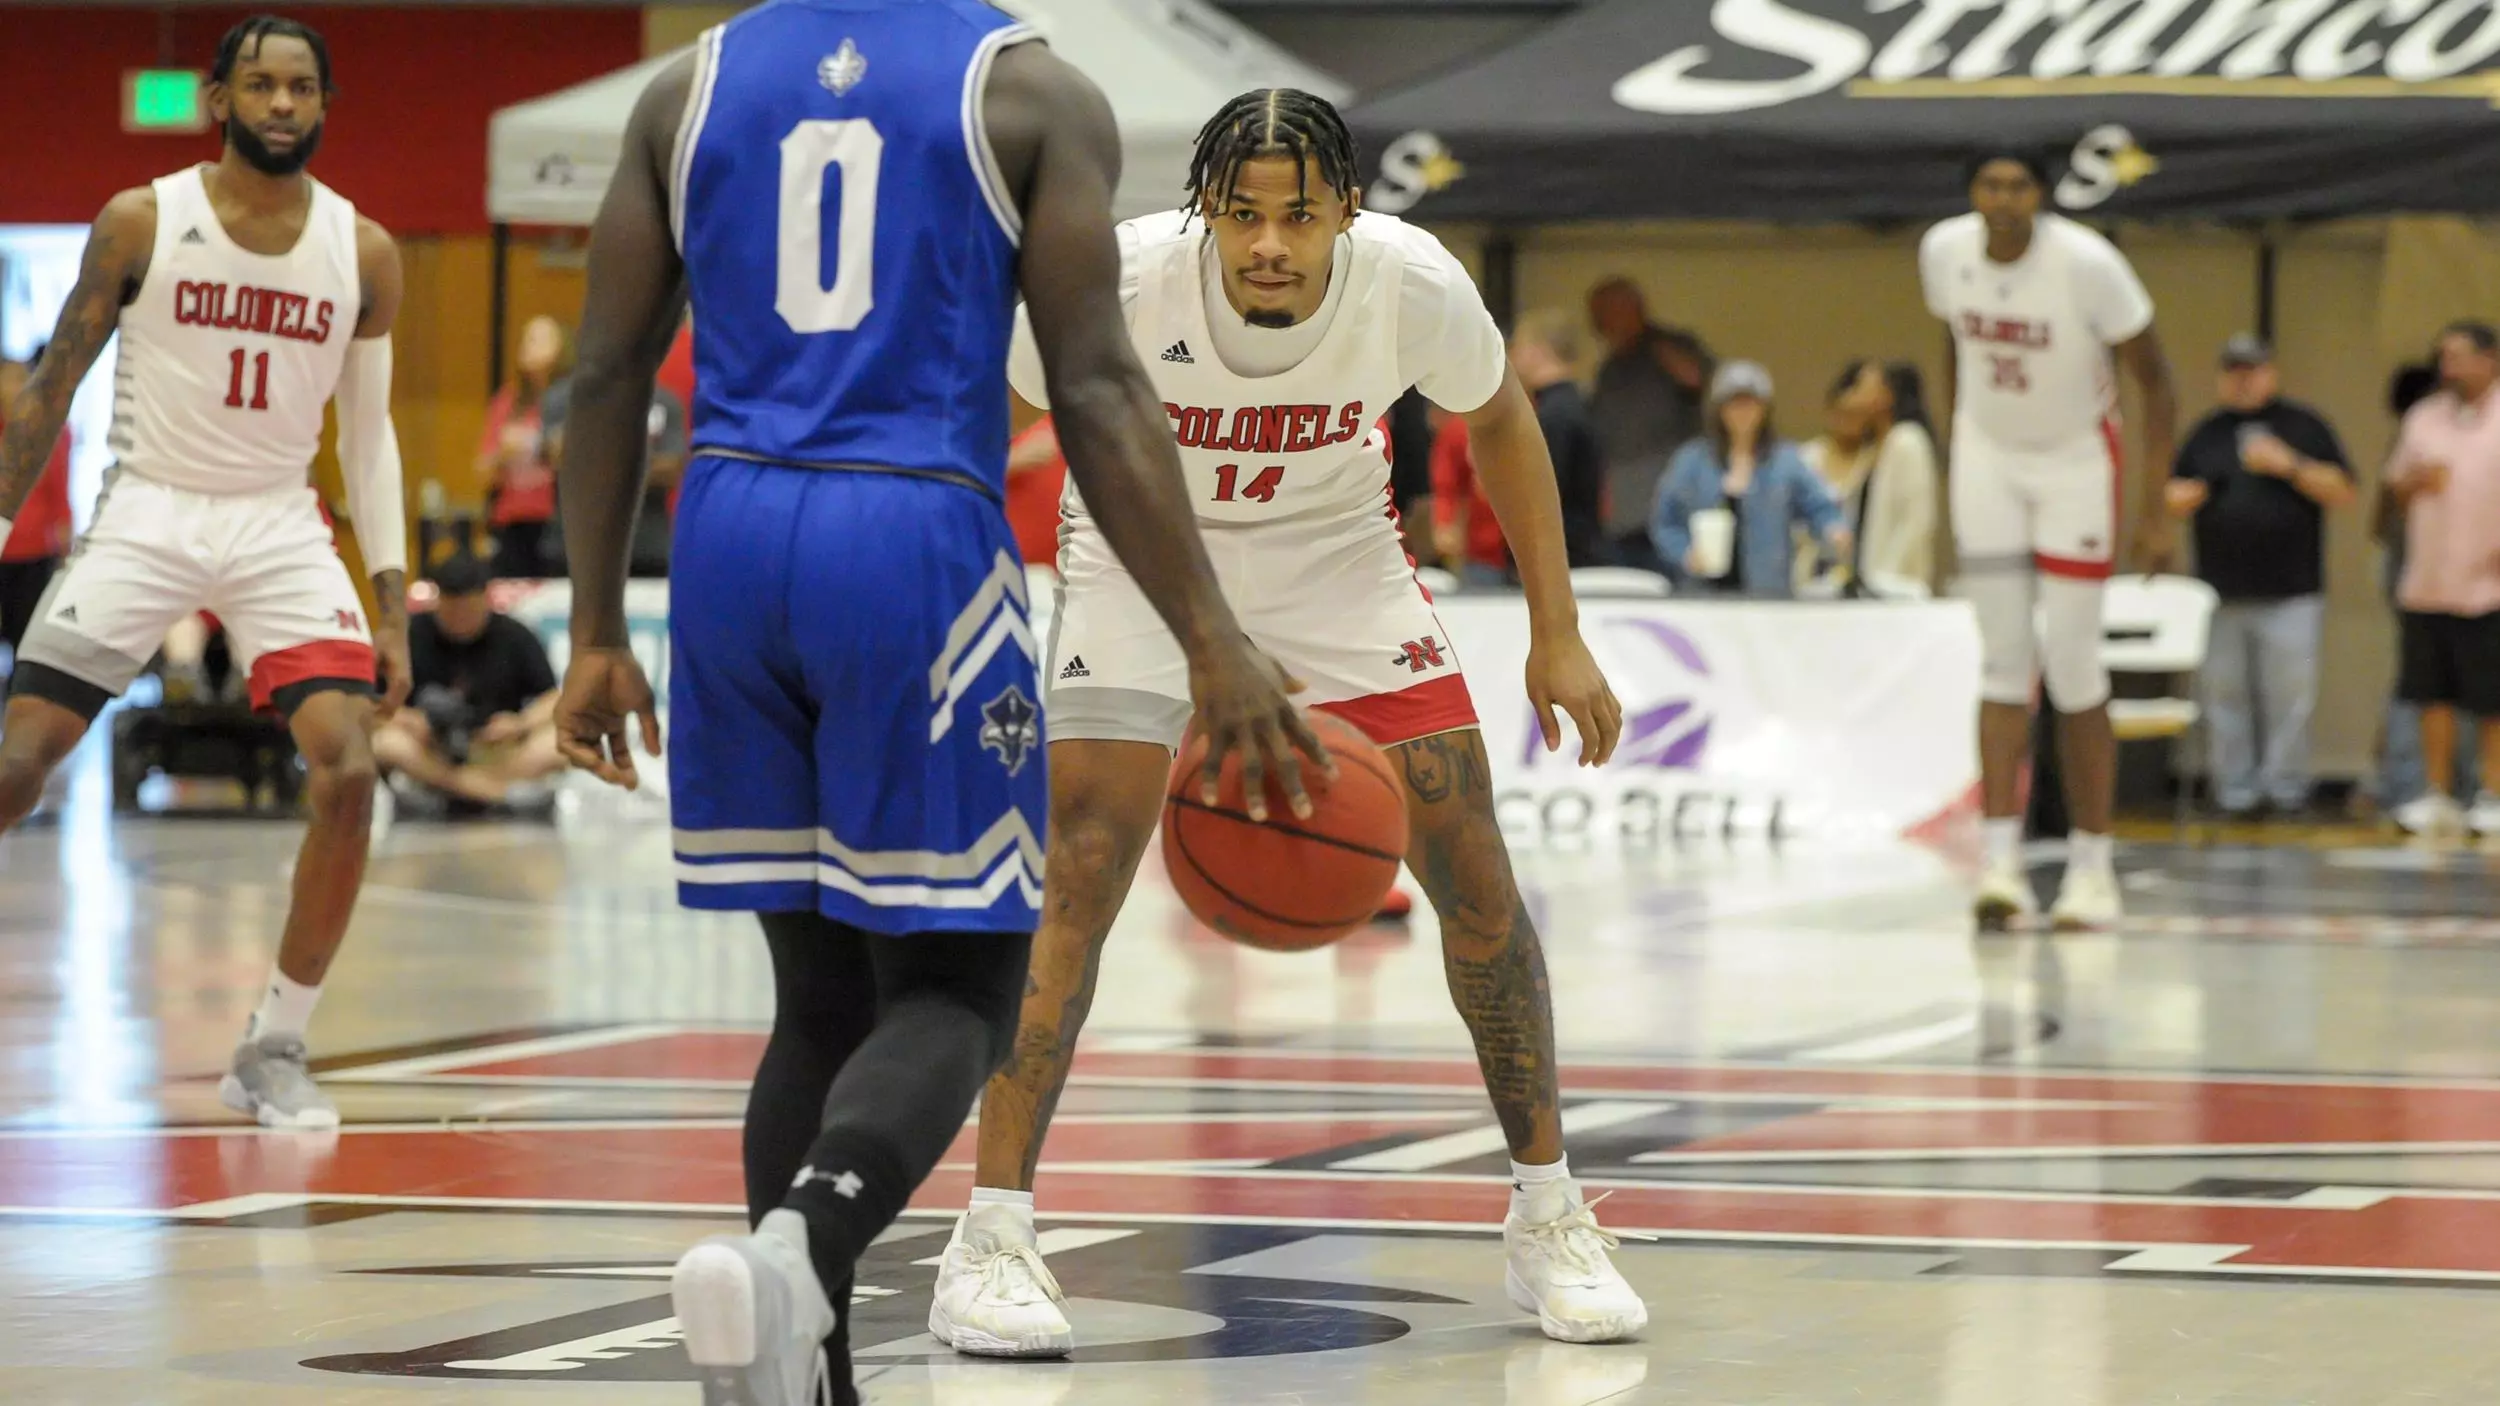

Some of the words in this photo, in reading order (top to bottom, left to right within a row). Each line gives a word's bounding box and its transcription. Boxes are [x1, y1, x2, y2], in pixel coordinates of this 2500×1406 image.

[774, 117, 884, 334] 0
[175, 280, 334, 344] COLONELS
[1161, 352, 1195, 364] adidas
[224, 347, 270, 410] 11
[1211, 463, 1285, 503] 14
[1400, 635, 1445, 673] N
[1059, 669, 1091, 680] adidas
